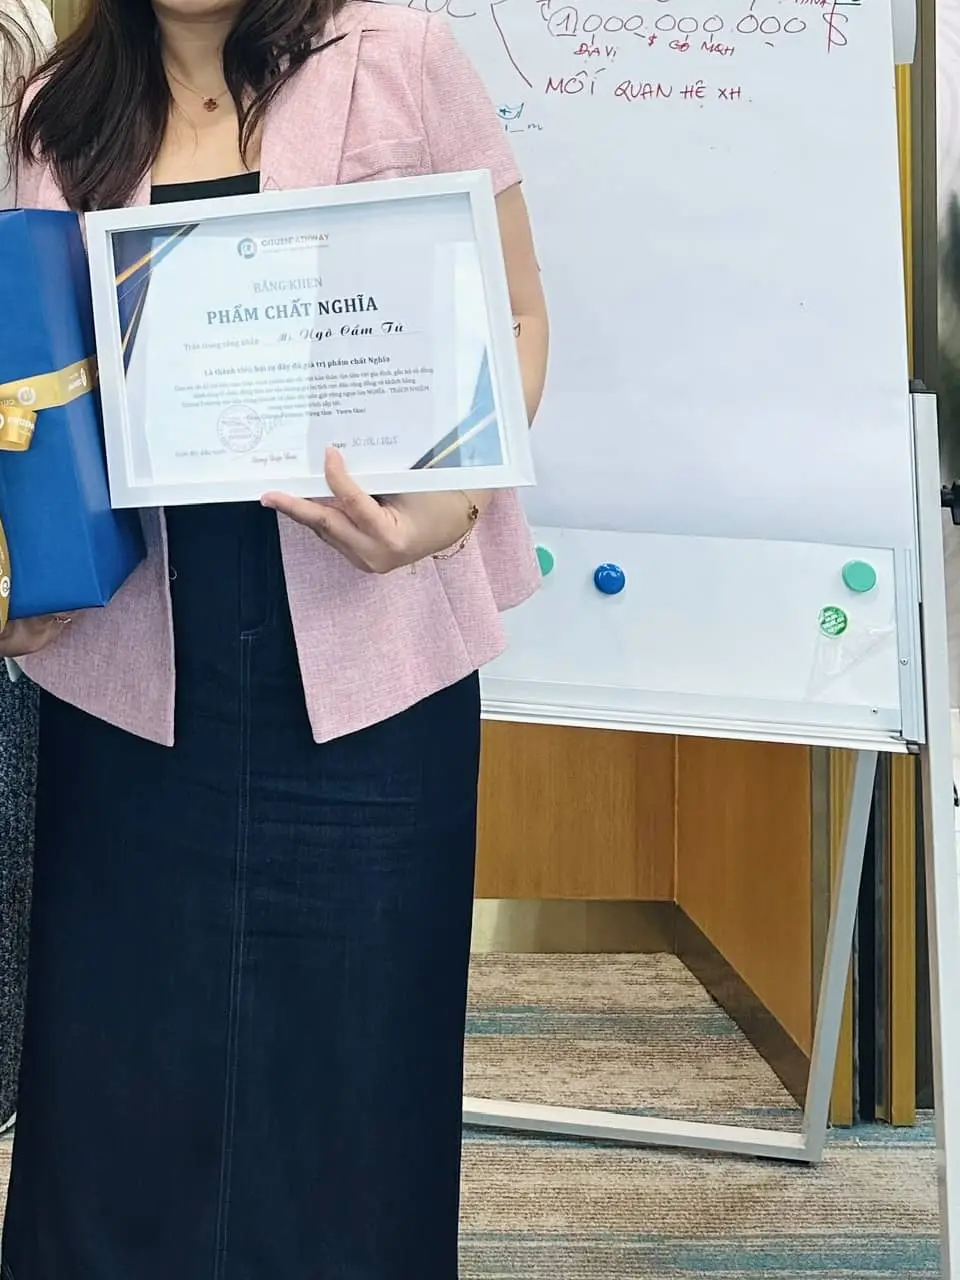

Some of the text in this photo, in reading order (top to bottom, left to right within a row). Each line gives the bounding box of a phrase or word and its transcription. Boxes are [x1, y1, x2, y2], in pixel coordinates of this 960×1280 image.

[614, 80, 674, 102] QUAN
[264, 297, 312, 321] CHẤT
[317, 294, 379, 317] NGHĨA
